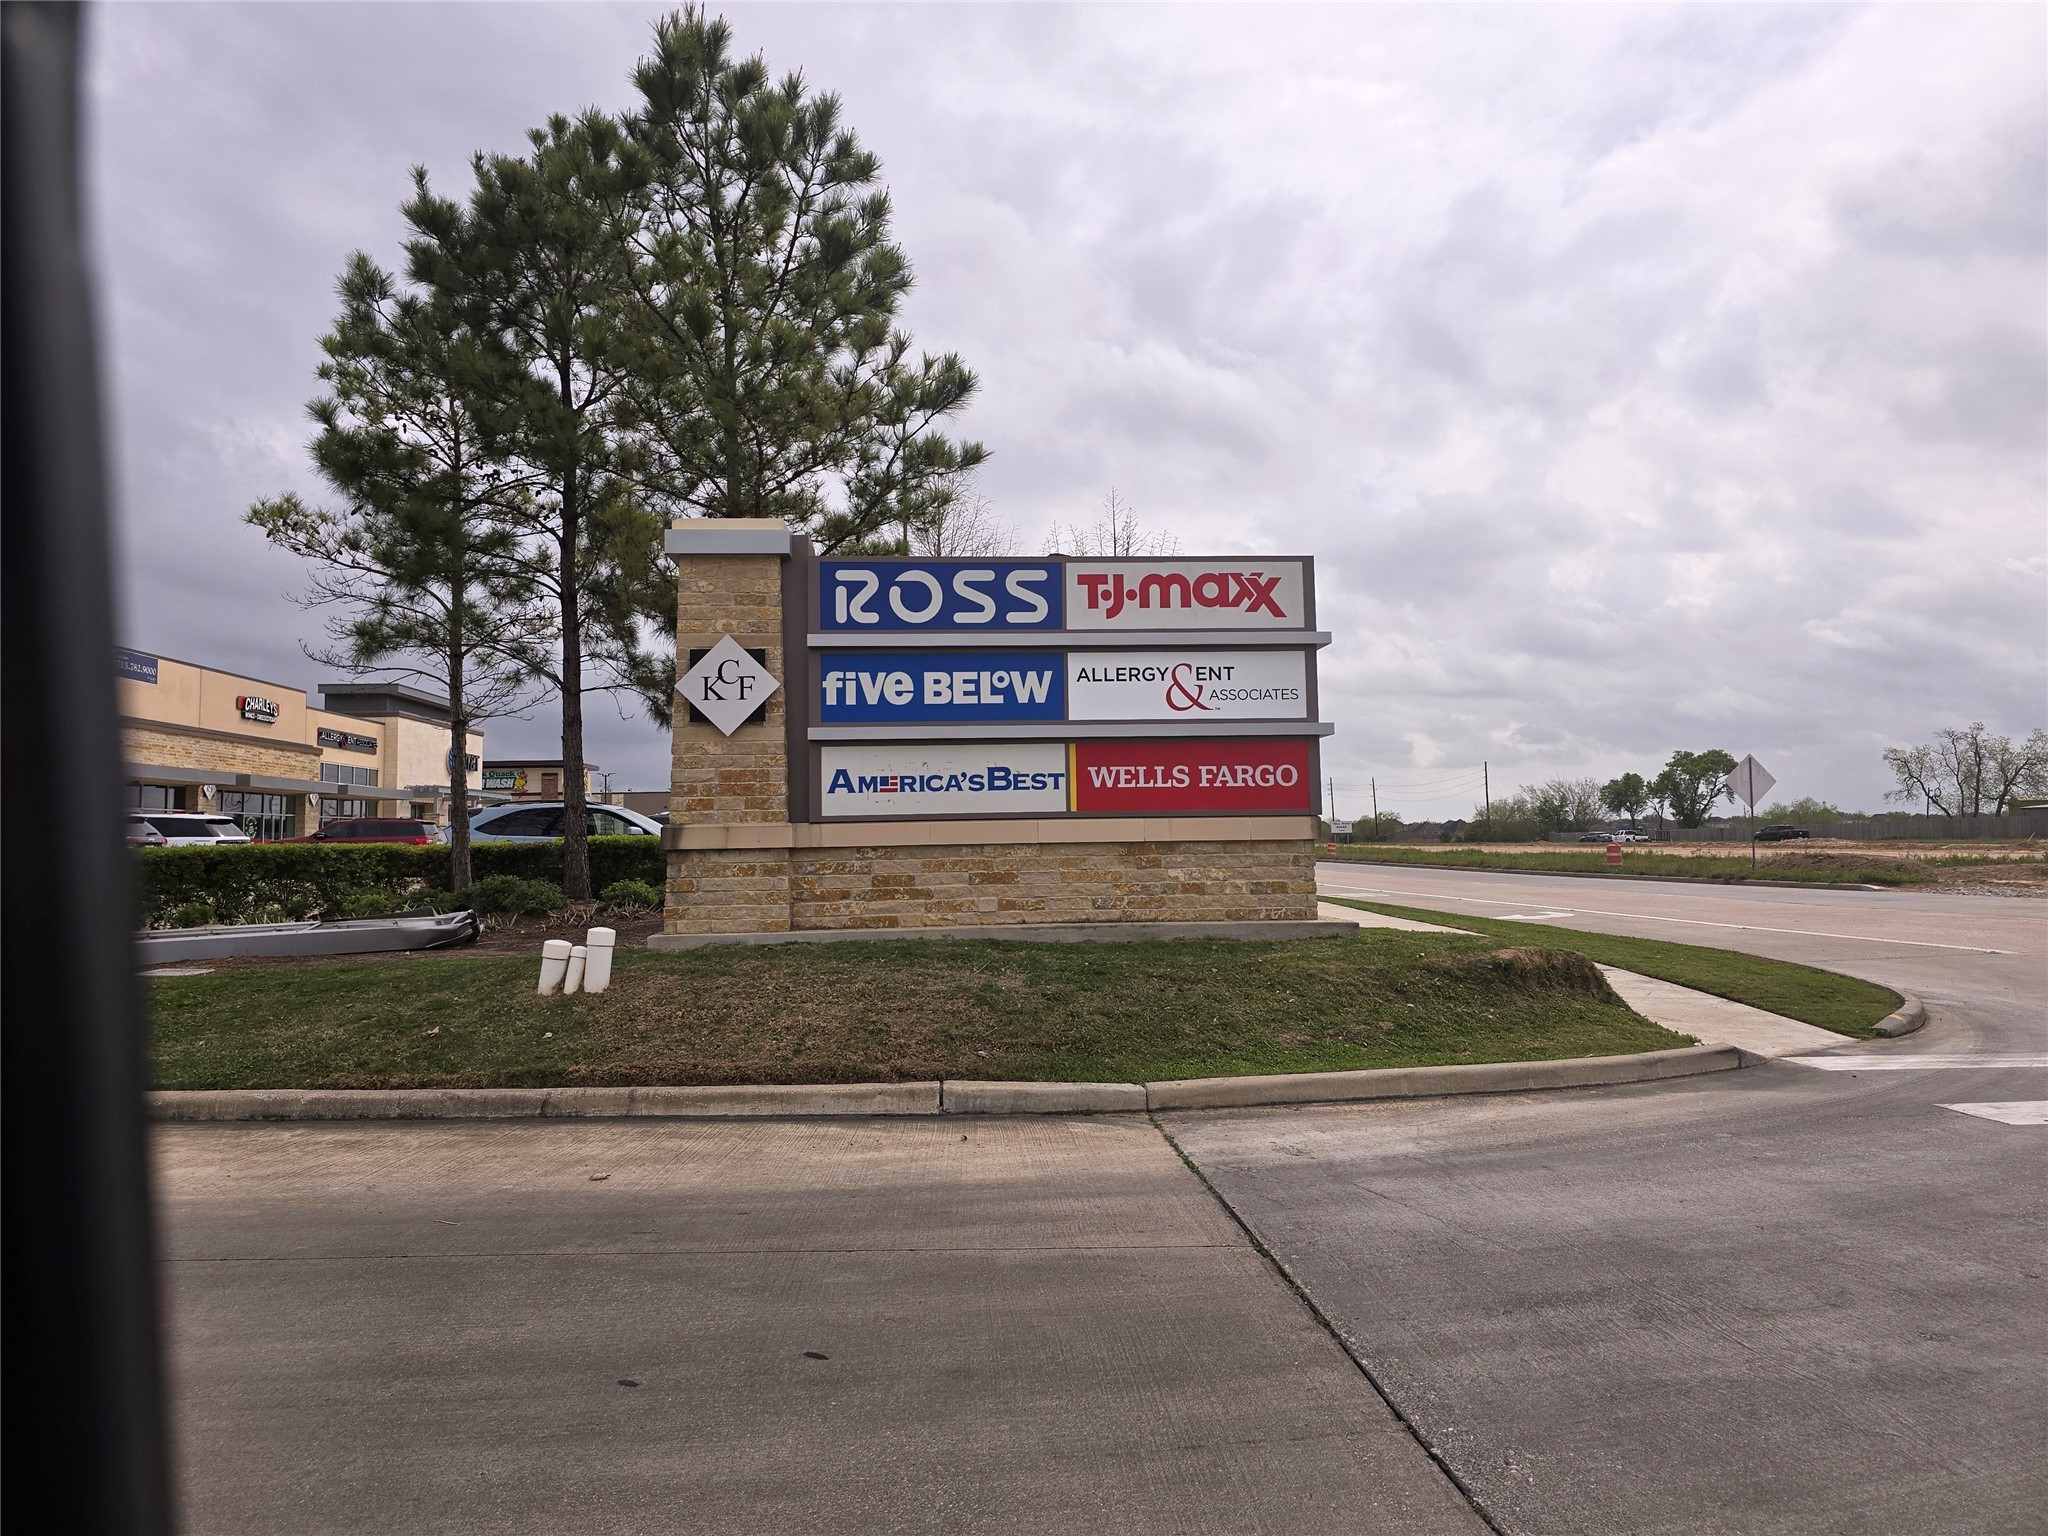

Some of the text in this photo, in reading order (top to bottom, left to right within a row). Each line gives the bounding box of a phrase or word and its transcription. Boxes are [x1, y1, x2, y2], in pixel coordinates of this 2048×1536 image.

[835, 569, 1048, 623] ROSS
[822, 670, 1053, 706] five BELOW
[1076, 662, 1235, 711] ALLERGY & ENT
[1209, 688, 1298, 701] ASSOCIATES
[320, 731, 343, 742] ALLERGY
[347, 736, 357, 744] ENT
[486, 778, 515, 788] WASH
[1087, 764, 1298, 788] WELLS FARGO
